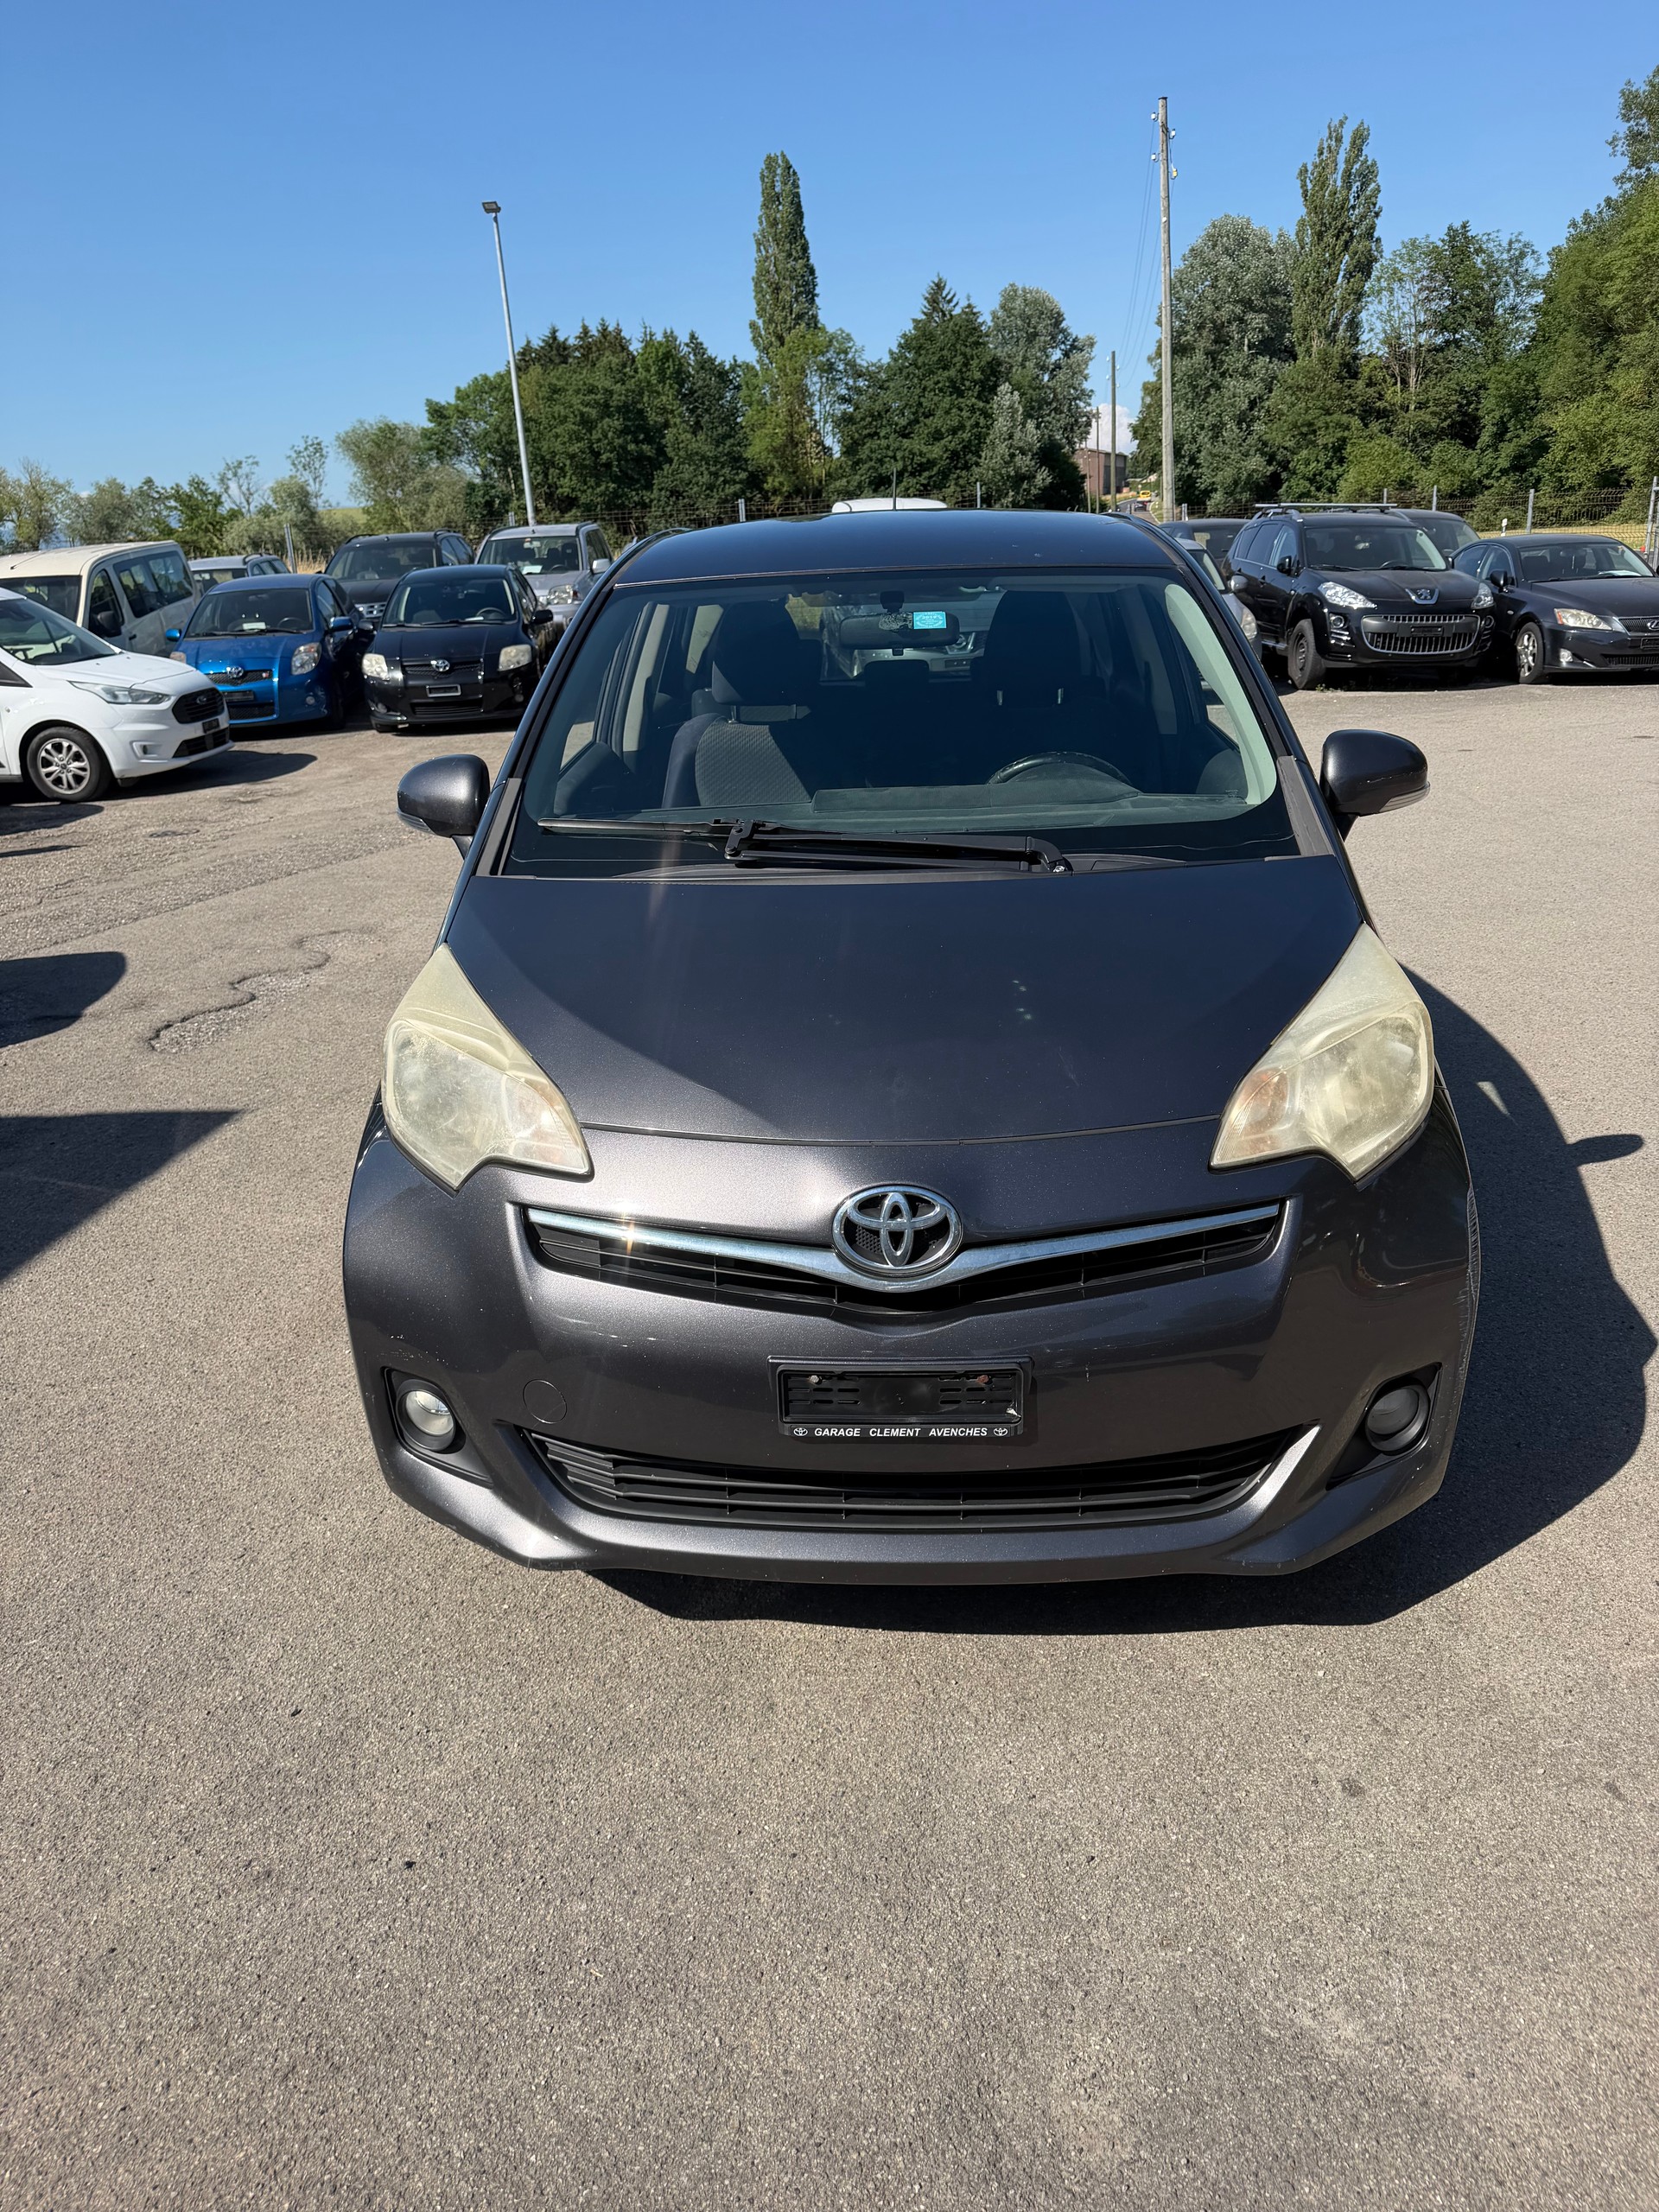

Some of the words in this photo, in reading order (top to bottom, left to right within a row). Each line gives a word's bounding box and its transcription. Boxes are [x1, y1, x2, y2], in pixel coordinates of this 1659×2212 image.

[815, 1427, 861, 1437] GARAGE
[869, 1427, 921, 1437] CLEMENT
[929, 1427, 988, 1437] AVENCHES
